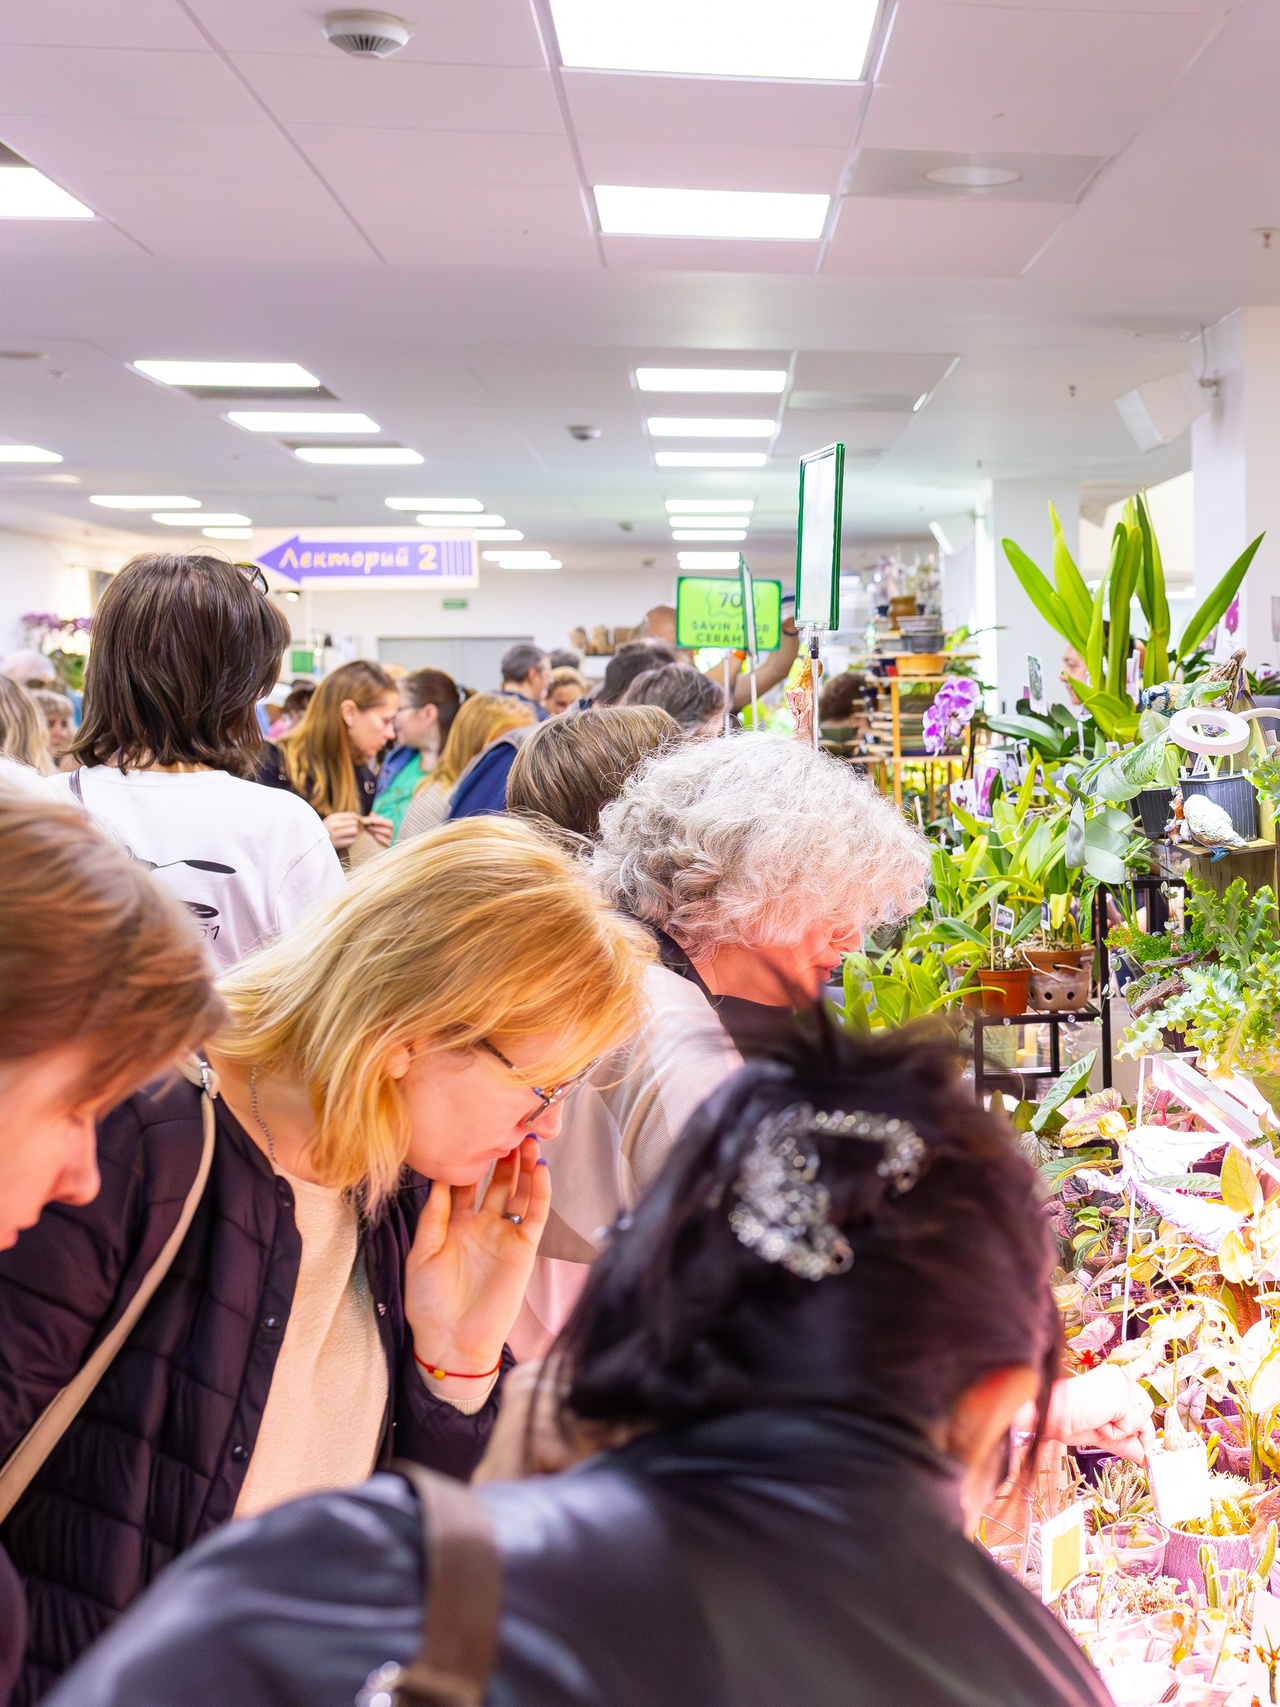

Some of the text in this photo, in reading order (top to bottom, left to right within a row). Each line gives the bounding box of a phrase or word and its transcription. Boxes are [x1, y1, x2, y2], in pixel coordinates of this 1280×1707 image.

[279, 544, 438, 574] Лекторий 2
[695, 632, 765, 646] CERAMS
